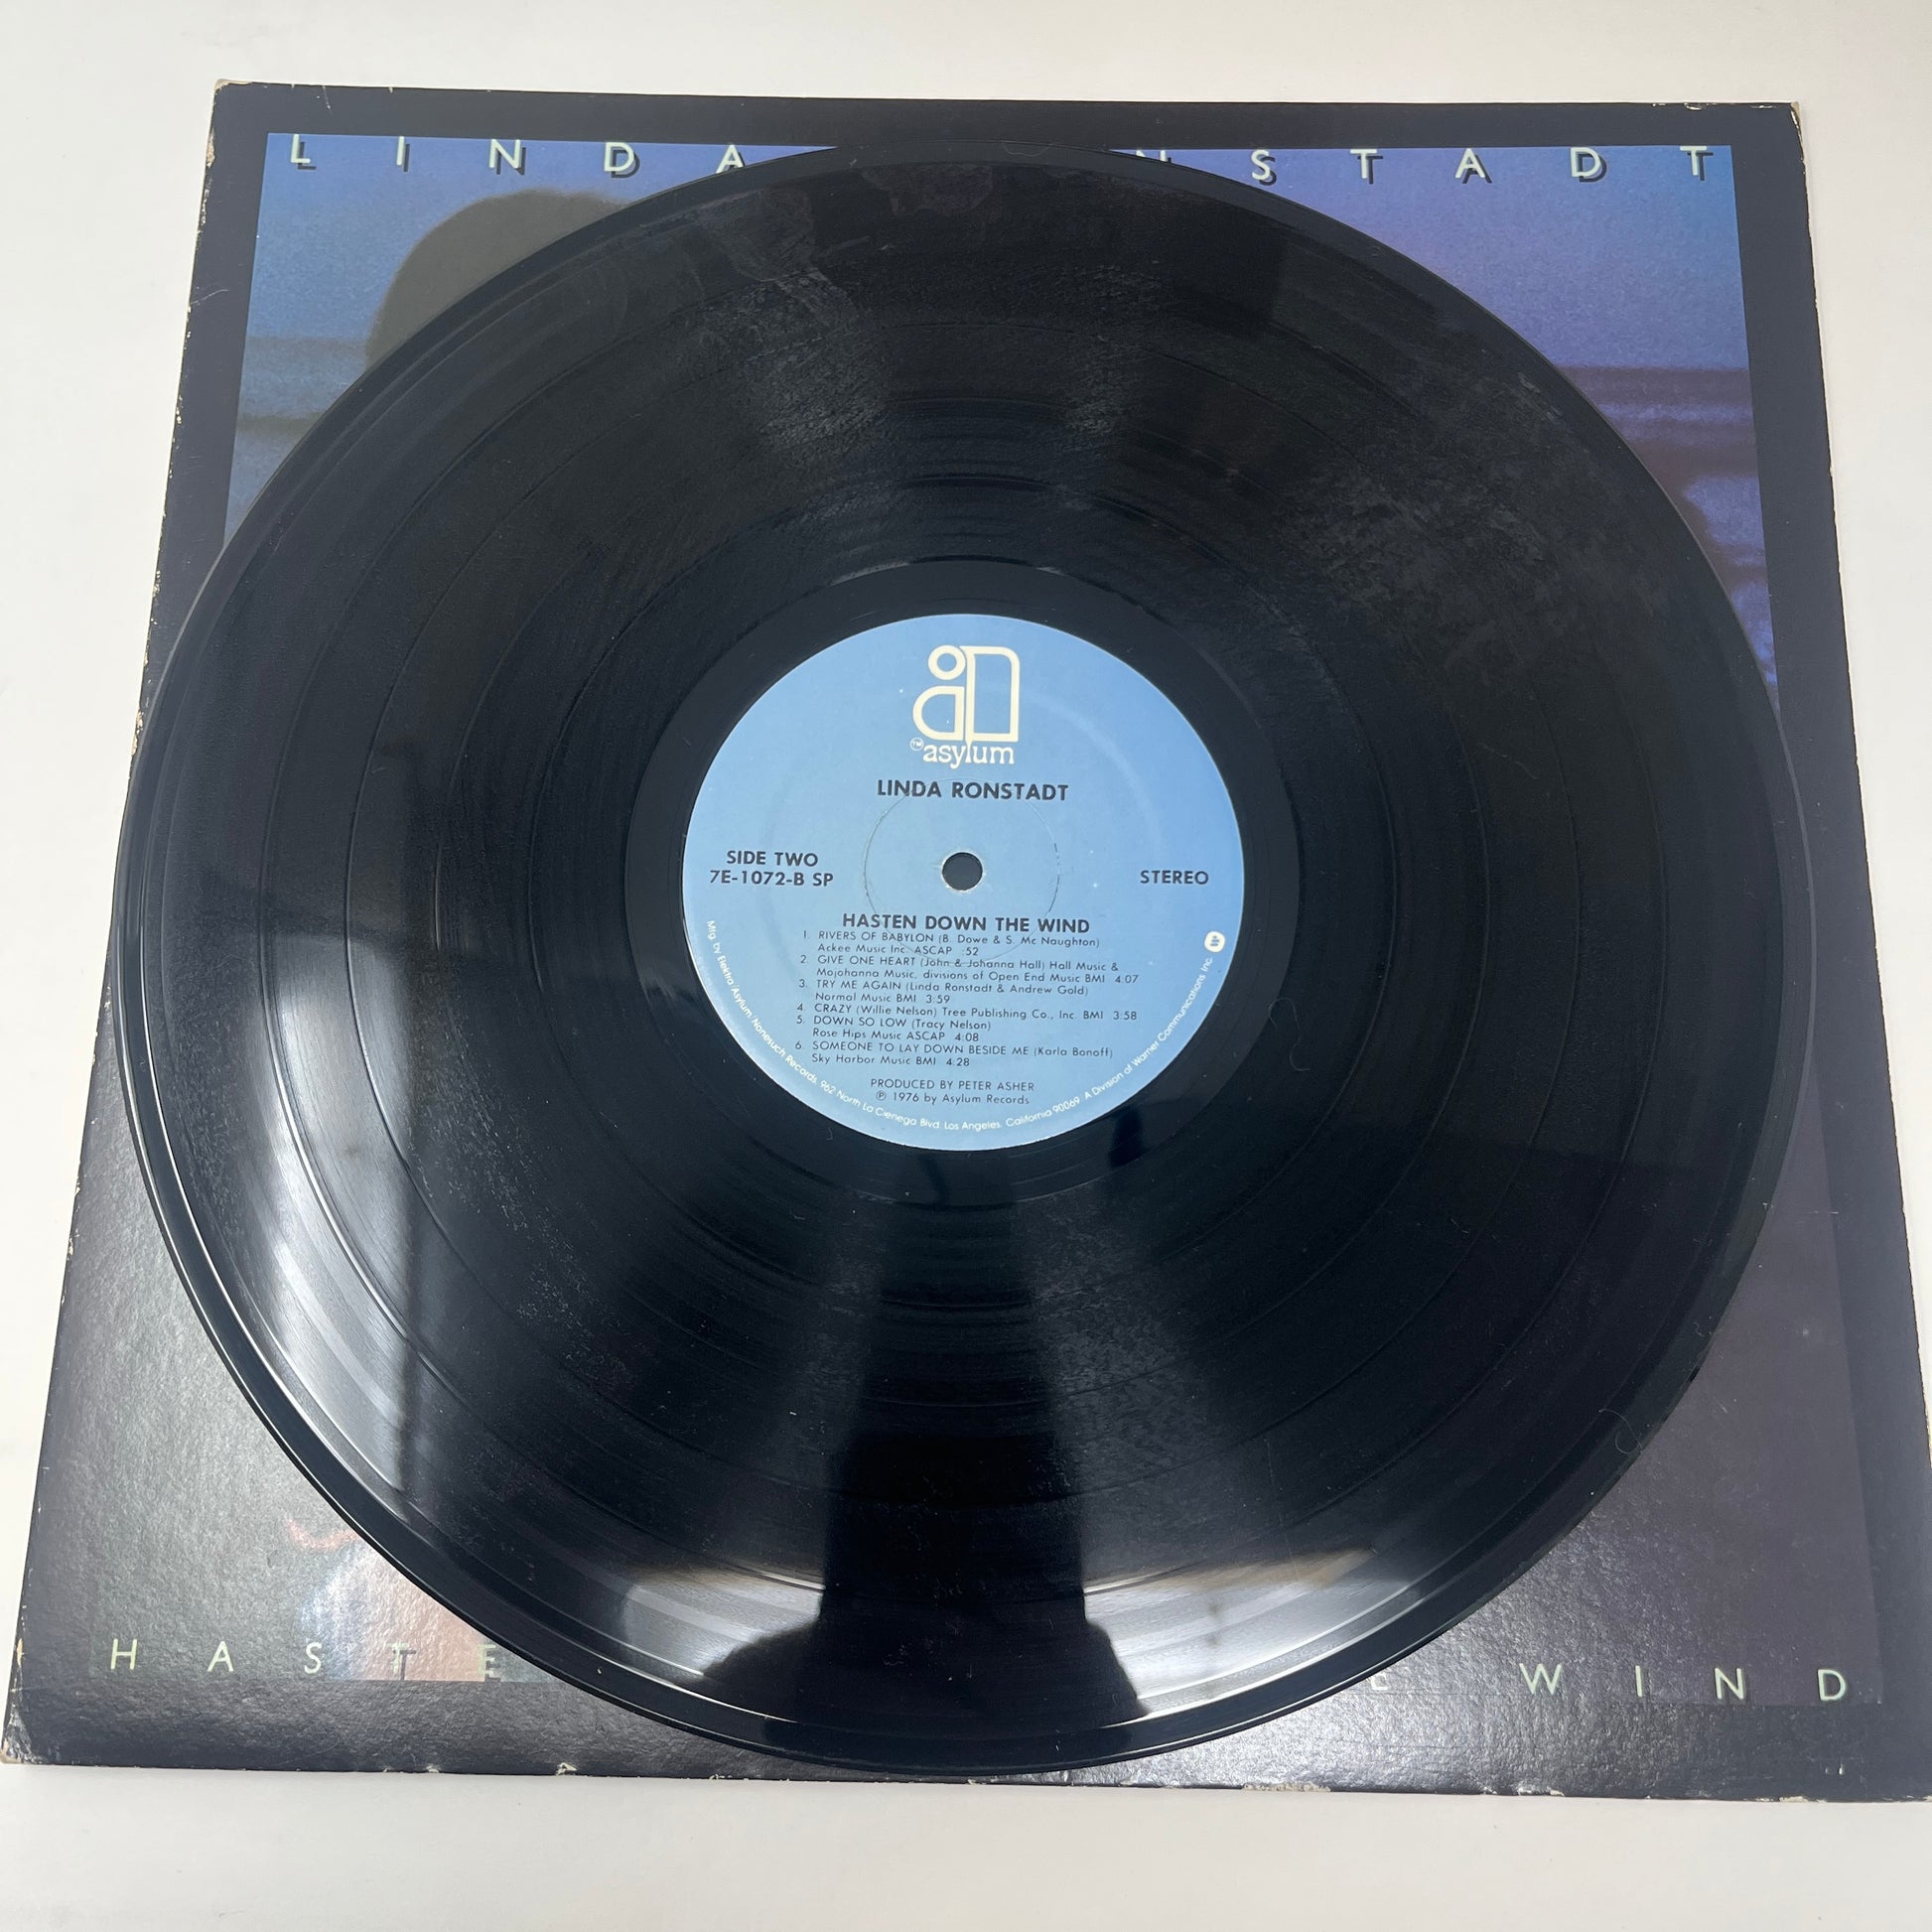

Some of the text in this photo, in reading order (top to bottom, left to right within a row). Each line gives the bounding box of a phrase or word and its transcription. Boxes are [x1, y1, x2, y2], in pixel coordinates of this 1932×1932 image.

[290, 133, 745, 178] LINDA
[922, 743, 1015, 768] asylum
[878, 779, 1068, 800] LINDA RONSTADT
[727, 850, 818, 867] SIDE TWO
[710, 870, 833, 887] 7E-1072-B SP
[1140, 870, 1208, 885] STEREO
[843, 913, 1089, 933] HASTEN DOWN THE WIND
[818, 931, 856, 940] RIVERS
[861, 931, 876, 941] OF
[882, 933, 933, 942] BABYLON
[957, 934, 988, 944] Dowe
[993, 935, 1000, 944] &
[1021, 936, 1035, 945] Mc
[1041, 937, 1100, 947] Naughton)
[818, 943, 851, 952] Ackee
[914, 946, 952, 955] ASCAP
[818, 955, 844, 964] GIVE
[849, 956, 875, 965] ONE
[881, 956, 915, 965] HEART
[920, 958, 949, 967] (John
[967, 959, 1014, 968] Johanna
[1020, 960, 1044, 970] Hall)
[1049, 961, 1070, 970] Hall
[1076, 962, 1105, 971] Music
[816, 968, 879, 979] Mojohanna
[923, 970, 967, 980] divisions
[973, 971, 984, 980] of
[989, 972, 1019, 982] Open
[1050, 973, 1080, 982] Music
[1085, 974, 1105, 983] BMI
[817, 980, 835, 989] TRY
[863, 981, 901, 990] AGAIN
[905, 982, 939, 992] (Linda
[945, 983, 992, 993] Ronstadt
[997, 984, 1004, 993] &
[1011, 985, 1052, 994] Andrew
[1057, 986, 1088, 996] Gold)
[814, 1004, 852, 1013] CRAZY
[857, 1005, 892, 1015] (Willie
[896, 1007, 937, 1017] Nelson)
[943, 1008, 966, 1017] Tree
[971, 1008, 1027, 1020] Publishing
[1083, 1011, 1103, 1020] BMI
[1113, 1011, 1137, 1020] 3:58
[813, 1016, 853, 1025] DOWN
[859, 1017, 875, 1026] SO
[880, 1018, 906, 1027] LOW
[911, 1019, 944, 1030] (Tracy
[950, 1020, 991, 1031] Nelson)
[713, 942, 722, 954] by
[820, 1080, 836, 1095] 962
[836, 1090, 861, 1107] North
[863, 1103, 874, 1113] La
[875, 1107, 917, 1126] Cienega
[944, 1121, 959, 1130] Los
[1006, 1109, 1052, 1127] California
[1052, 1096, 1080, 1114] 90069
[1084, 1091, 1092, 1100] A
[1091, 1072, 1124, 1096] Division
[1124, 1064, 1133, 1074] of
[1131, 1040, 1160, 1066] Warner
[1158, 974, 1206, 1041] Communications
[813, 1028, 979, 1041] Rose Hips Music ASCAP 4:08
[812, 1041, 873, 1051] SOMEONE
[879, 1042, 894, 1051] TO
[924, 1044, 964, 1054] DOWN
[969, 1045, 1006, 1054] BESIDE
[1035, 1047, 1066, 1057] (Karla
[1072, 1047, 1113, 1058] Bonoff)
[812, 1053, 830, 1064] Sky
[836, 1054, 875, 1063] Harbor
[915, 1056, 935, 1065] BMI
[871, 1079, 1035, 1091] PRODUCED BY PETER ASHER
[894, 1092, 919, 1102] 1976
[924, 1093, 936, 1104] by
[942, 1094, 981, 1105] Asylum
[987, 1095, 1030, 1104] Records
[110, 1638, 1847, 1702] HASTE WIND
